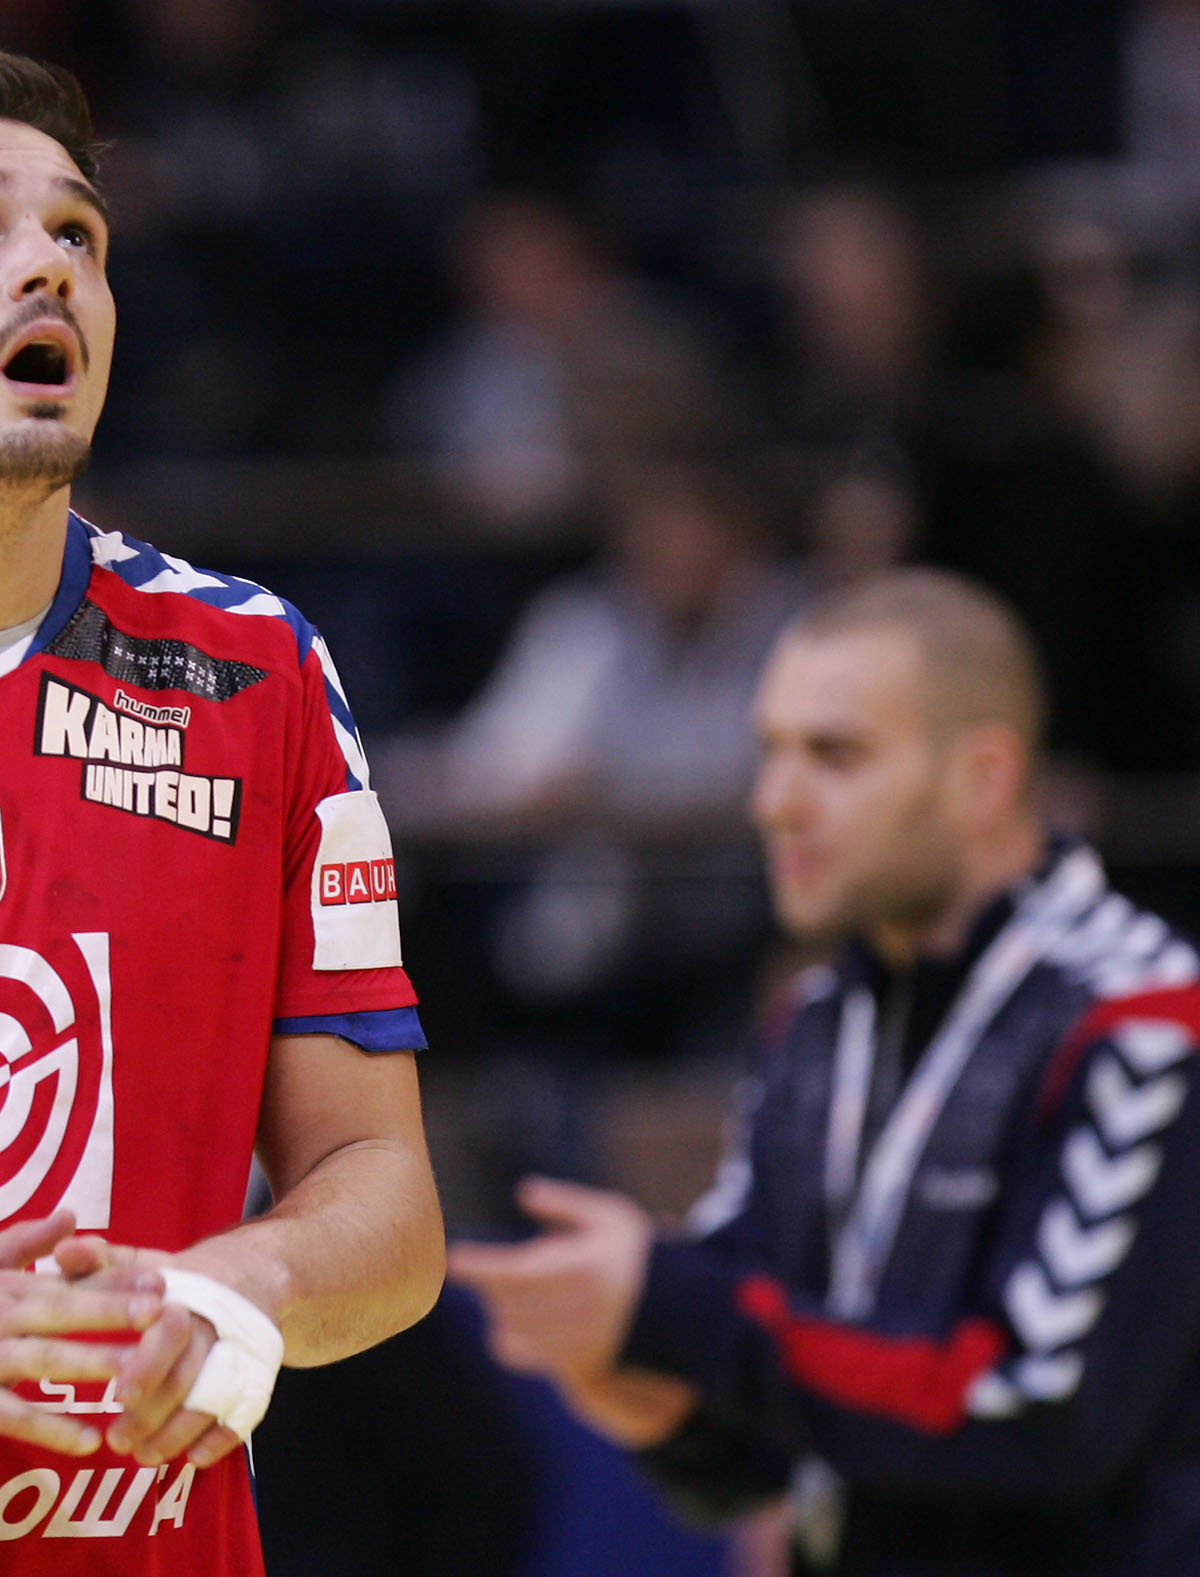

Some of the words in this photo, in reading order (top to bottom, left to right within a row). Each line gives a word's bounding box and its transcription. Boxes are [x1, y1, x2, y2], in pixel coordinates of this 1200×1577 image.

[41, 681, 181, 767] KARMA
[114, 690, 191, 727] hummel
[85, 765, 235, 839] UNITED!
